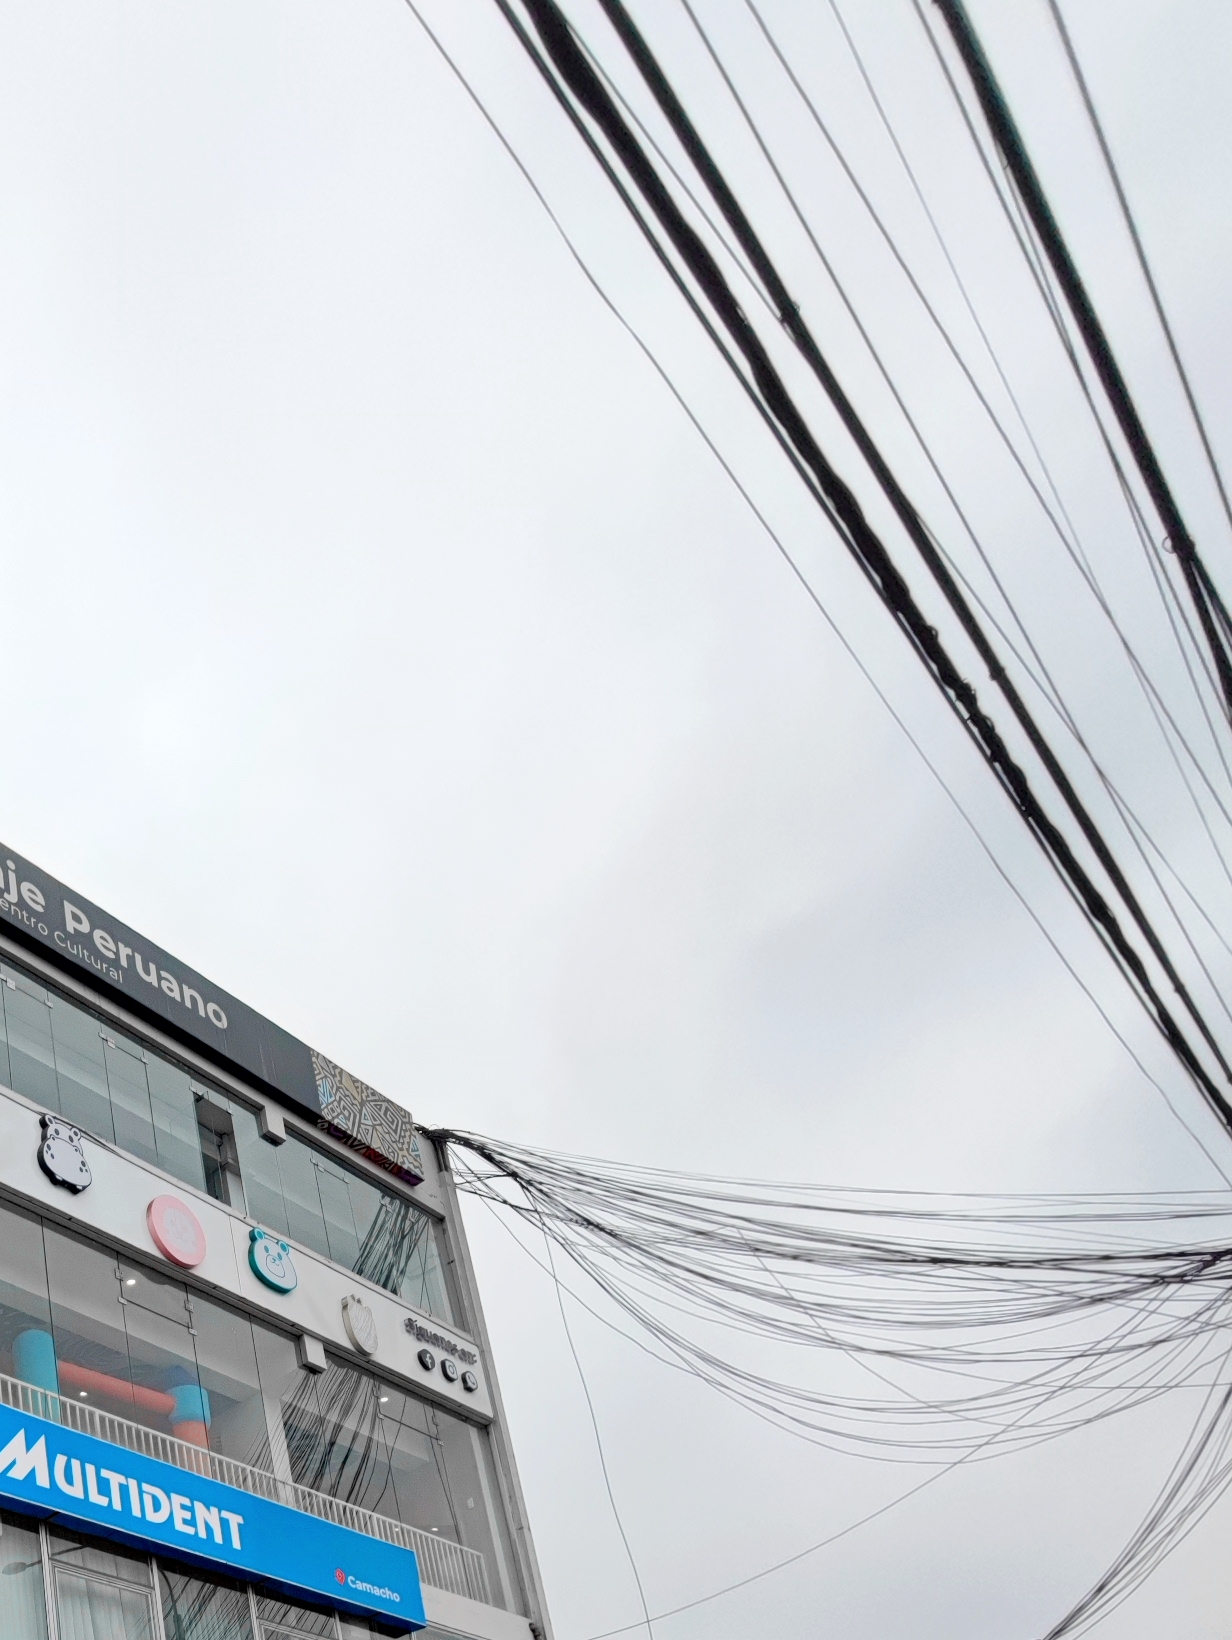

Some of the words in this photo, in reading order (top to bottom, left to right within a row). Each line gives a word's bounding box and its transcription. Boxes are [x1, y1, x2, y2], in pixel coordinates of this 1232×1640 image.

[54, 931, 123, 984] Cultural
[64, 899, 228, 1030] Peruano
[348, 1575, 401, 1603] Camacho
